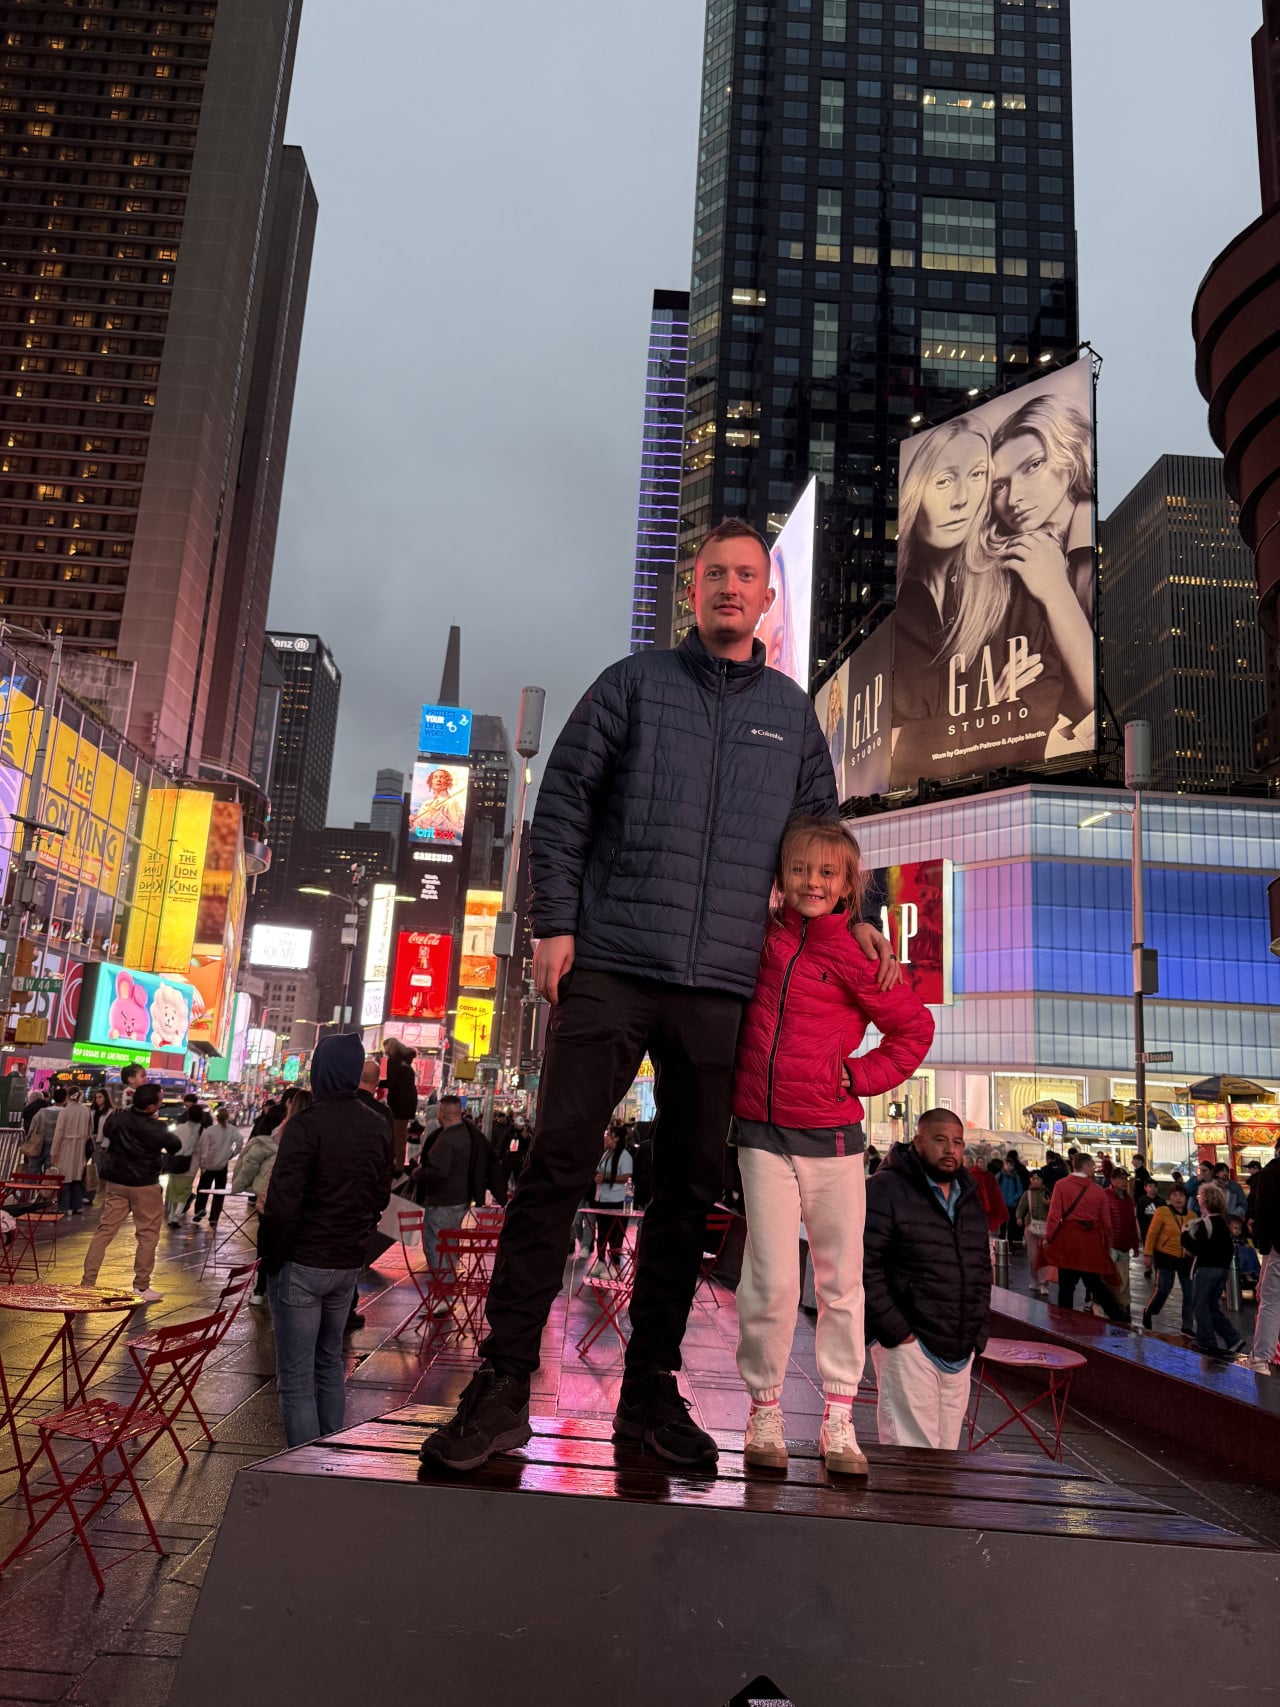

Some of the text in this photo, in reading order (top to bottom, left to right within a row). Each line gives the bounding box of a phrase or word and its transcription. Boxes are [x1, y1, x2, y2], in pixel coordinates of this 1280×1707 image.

[949, 635, 1028, 717] GAP
[425, 714, 445, 724] YOUR
[852, 673, 883, 750] GAP
[948, 707, 1028, 735] STUDIO
[251, 698, 271, 774] TIMES
[757, 729, 784, 741] Columbia
[851, 737, 882, 766] STUDIO
[931, 752, 946, 760] Worn
[946, 750, 954, 758] by
[953, 744, 980, 756] Gwyneth
[979, 740, 1001, 750] Paltrow
[1006, 735, 1025, 745] Apple
[1024, 730, 1047, 740] Martin.
[66, 755, 94, 794] THE
[74, 801, 117, 864] KING
[415, 826, 455, 840] britbox
[179, 854, 197, 863] THE
[413, 851, 454, 863] SAMSUNG
[173, 864, 198, 879] LION
[168, 880, 199, 895] KING
[408, 931, 442, 946] Coca-Cola
[26, 979, 35, 990] W
[39, 980, 50, 991] 44
